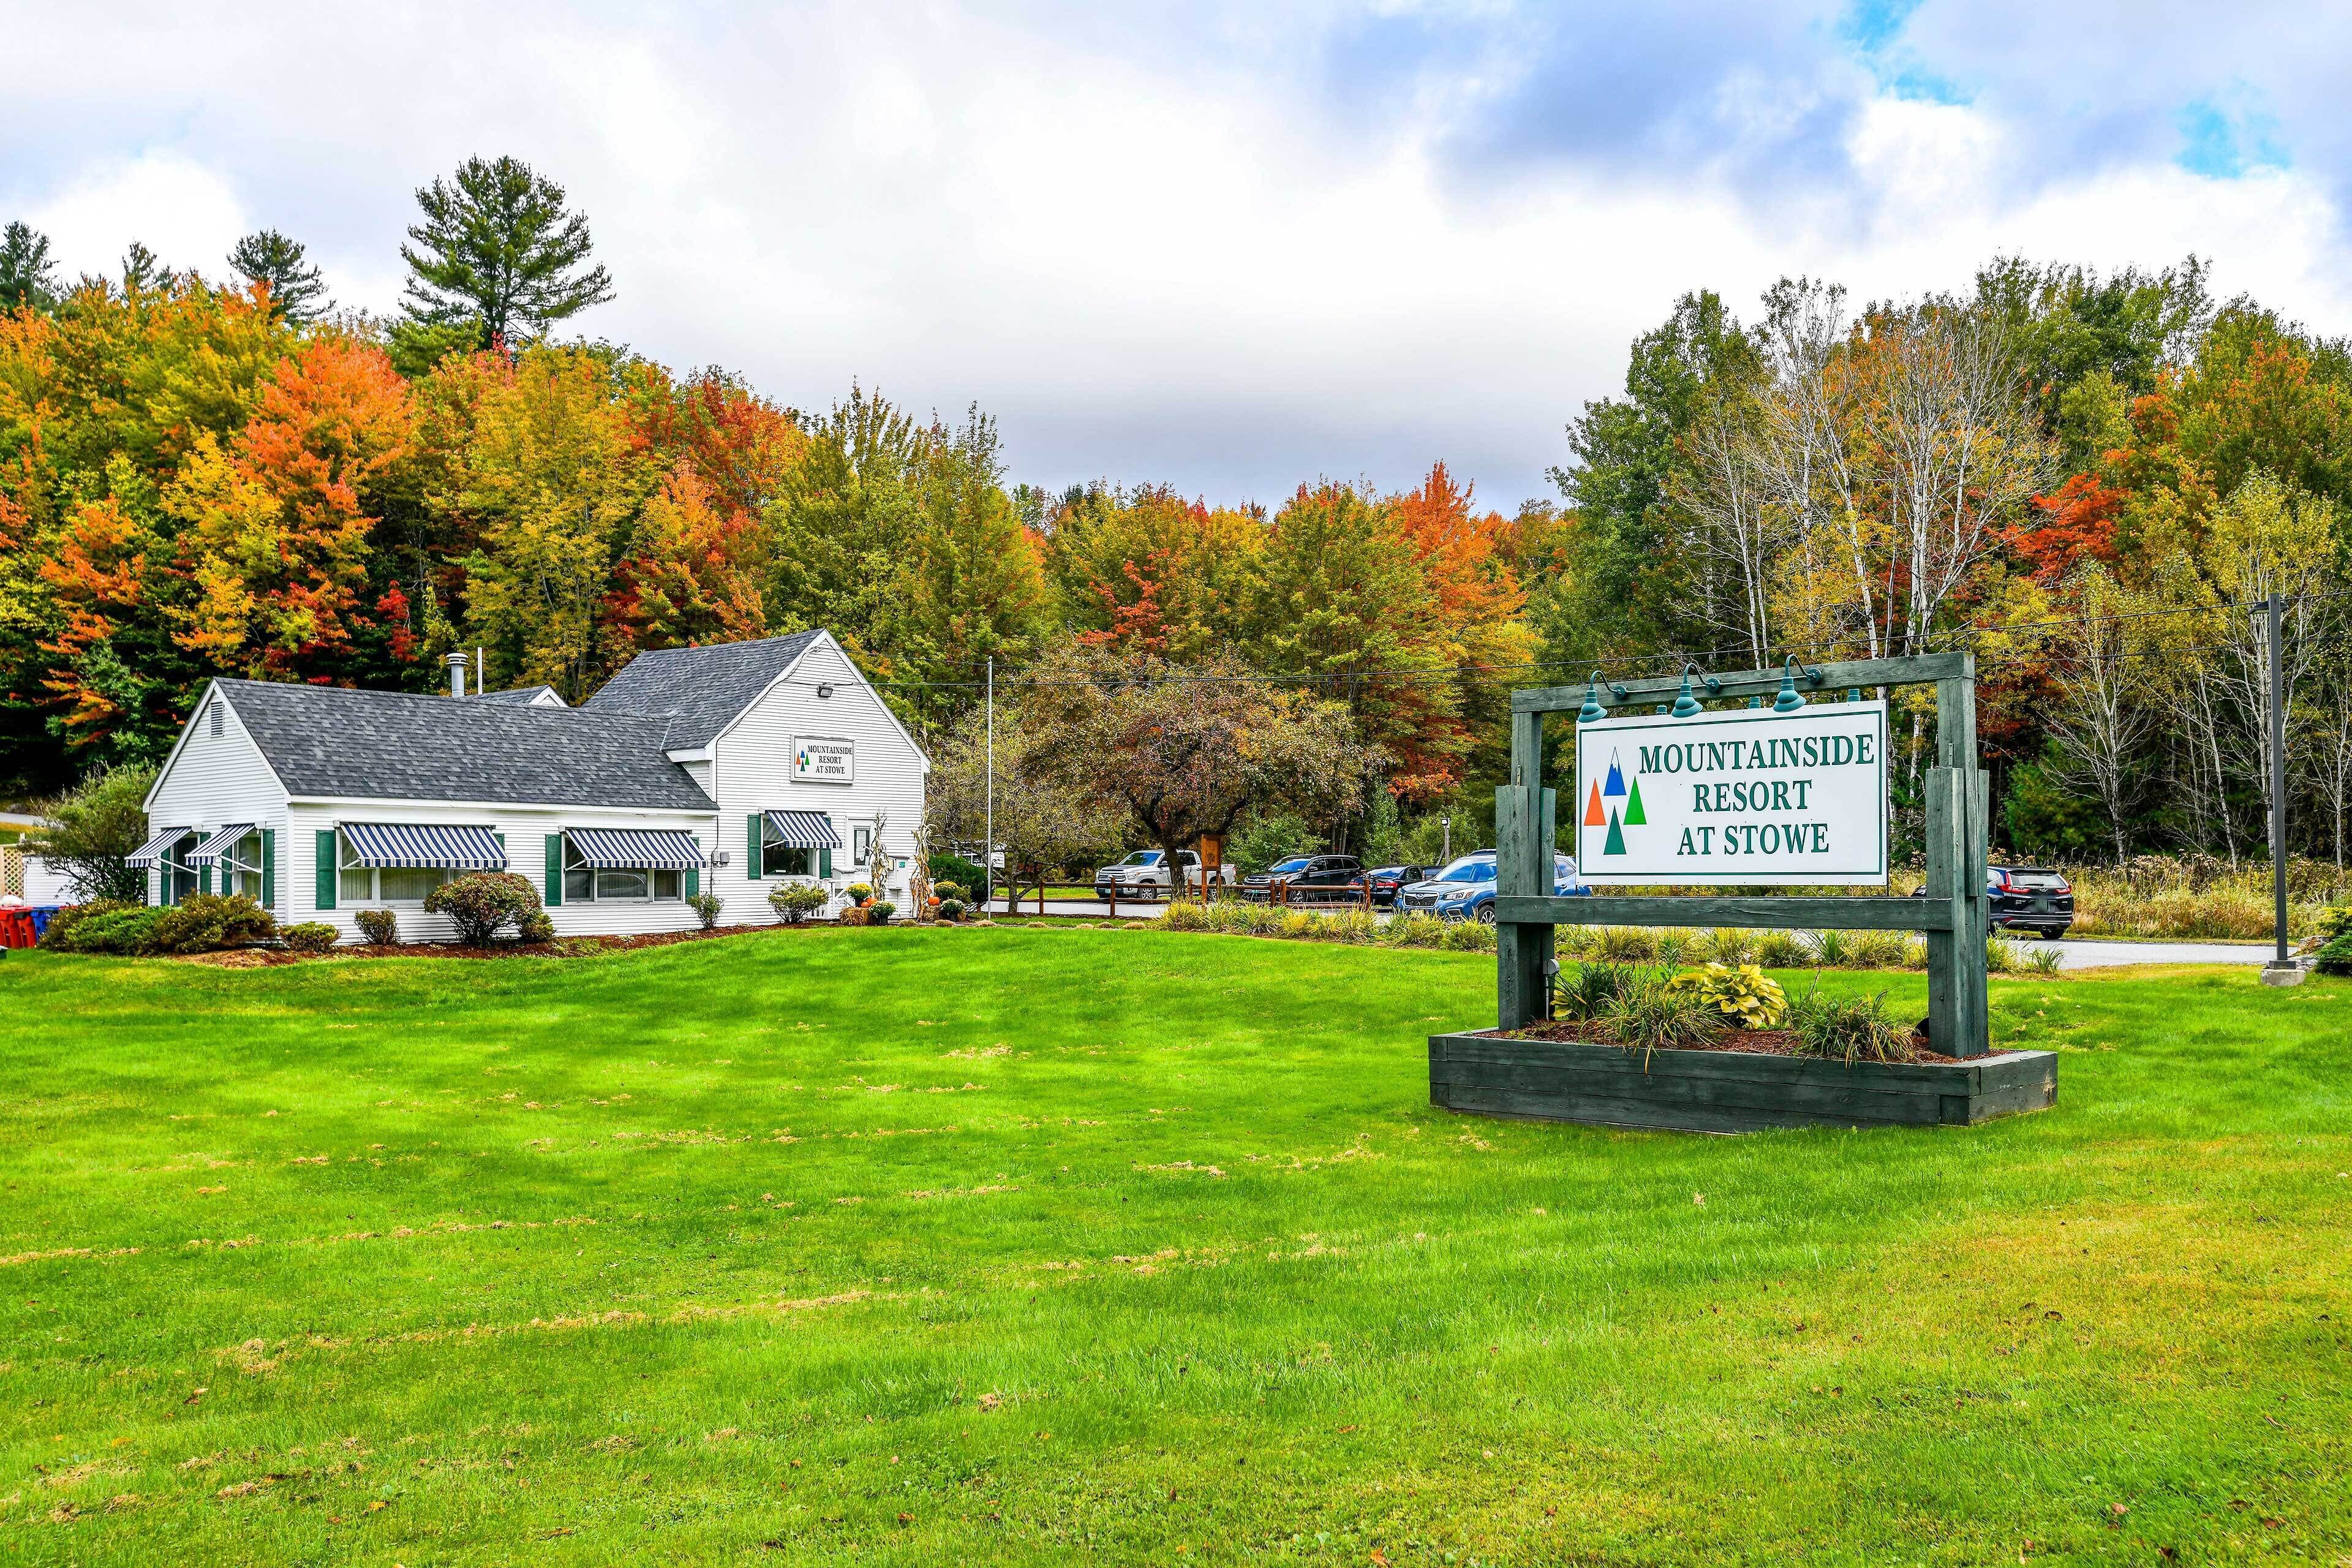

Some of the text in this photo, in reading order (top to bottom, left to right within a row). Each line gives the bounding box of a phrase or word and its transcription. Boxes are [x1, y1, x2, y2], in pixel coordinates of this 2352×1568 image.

[807, 745, 853, 755] MOUNTAINSIDE
[818, 755, 842, 764] RESORT
[1639, 734, 1874, 774] MOUNTAINSIDE
[824, 766, 845, 774] STOWE
[1693, 779, 1812, 812] RESORT
[1677, 823, 1829, 855] AT STOWE
